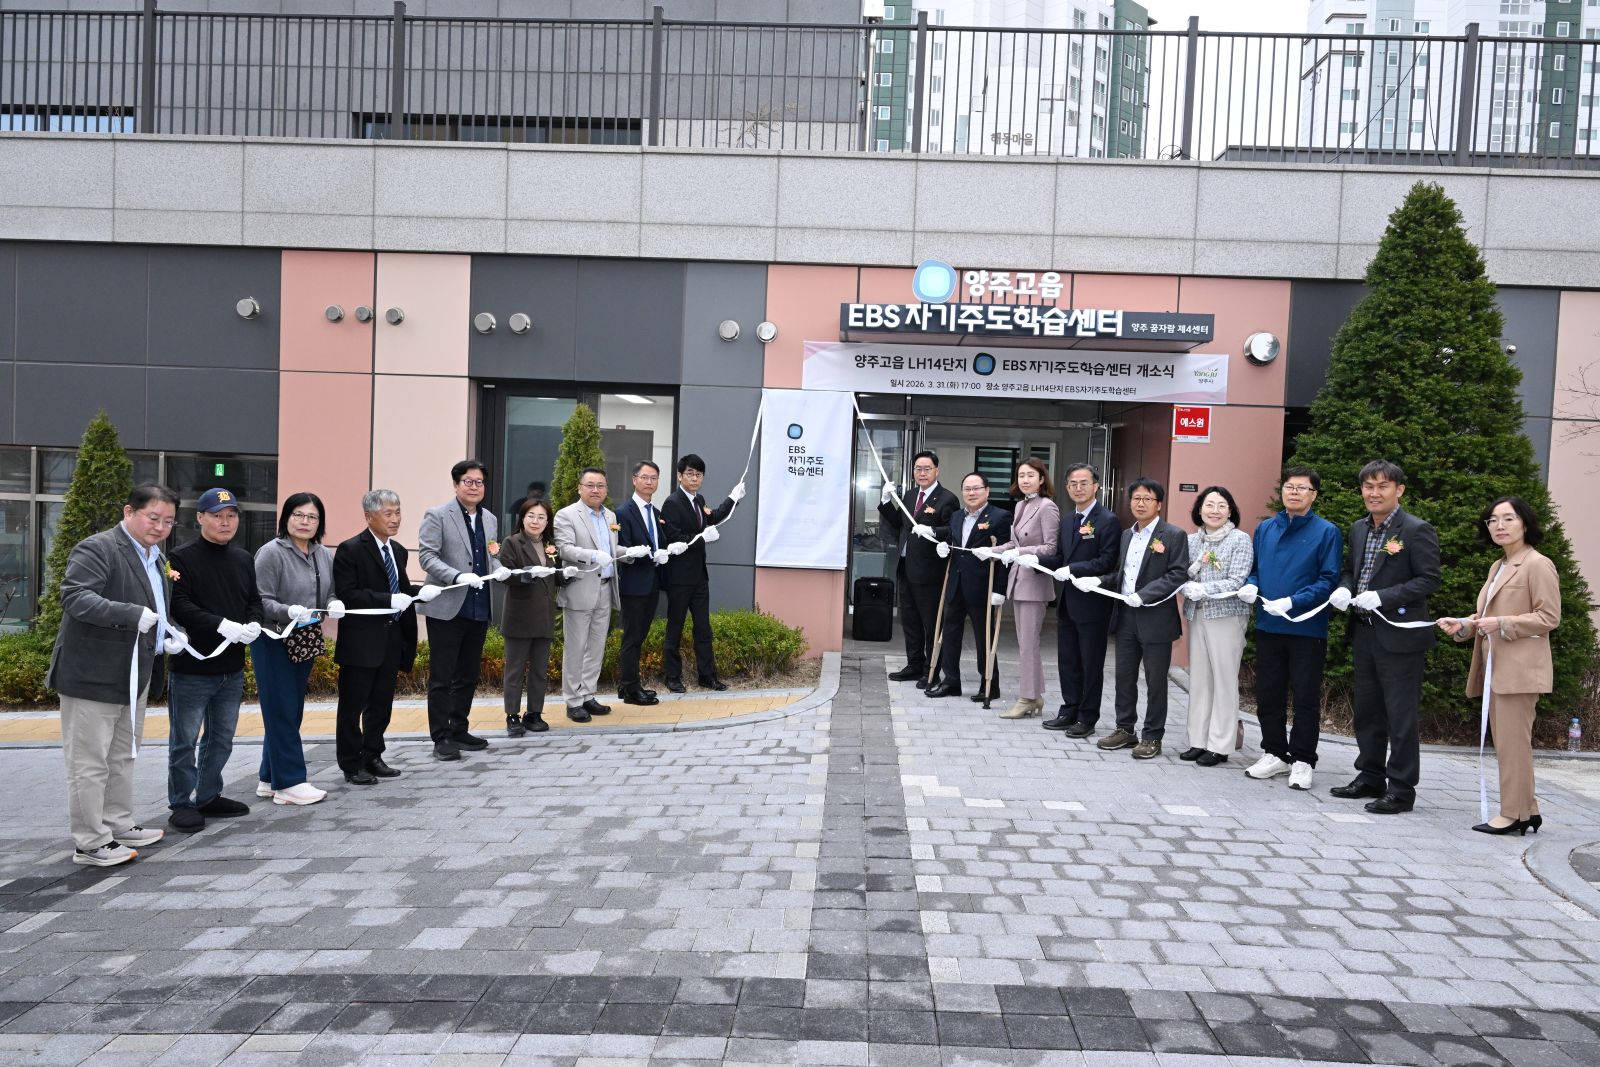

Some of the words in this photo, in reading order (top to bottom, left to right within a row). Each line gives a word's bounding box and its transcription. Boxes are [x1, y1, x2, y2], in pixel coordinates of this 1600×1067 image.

[990, 132, 1034, 146] 해동마을
[964, 270, 1063, 298] 양주고읍
[849, 303, 900, 328] EBS
[905, 303, 1123, 336] 자기주도학습센터
[1131, 323, 1149, 333] 양주
[1150, 323, 1176, 335] 꿈자람
[1177, 324, 1209, 335] 제4센터
[854, 354, 905, 370] 양주고읍
[908, 357, 967, 372] LH14단지
[1136, 364, 1175, 379] 개소식
[890, 379, 904, 389] 일시
[961, 382, 982, 390] 17:00
[985, 382, 1000, 391] 장소
[1001, 384, 1030, 393] 양주고읍
[1031, 385, 1063, 394] LH14단지
[1180, 418, 1205, 428] 에스원
[788, 445, 806, 454] EBS
[788, 455, 825, 465] 자기주도
[788, 466, 824, 476] 학습센터
